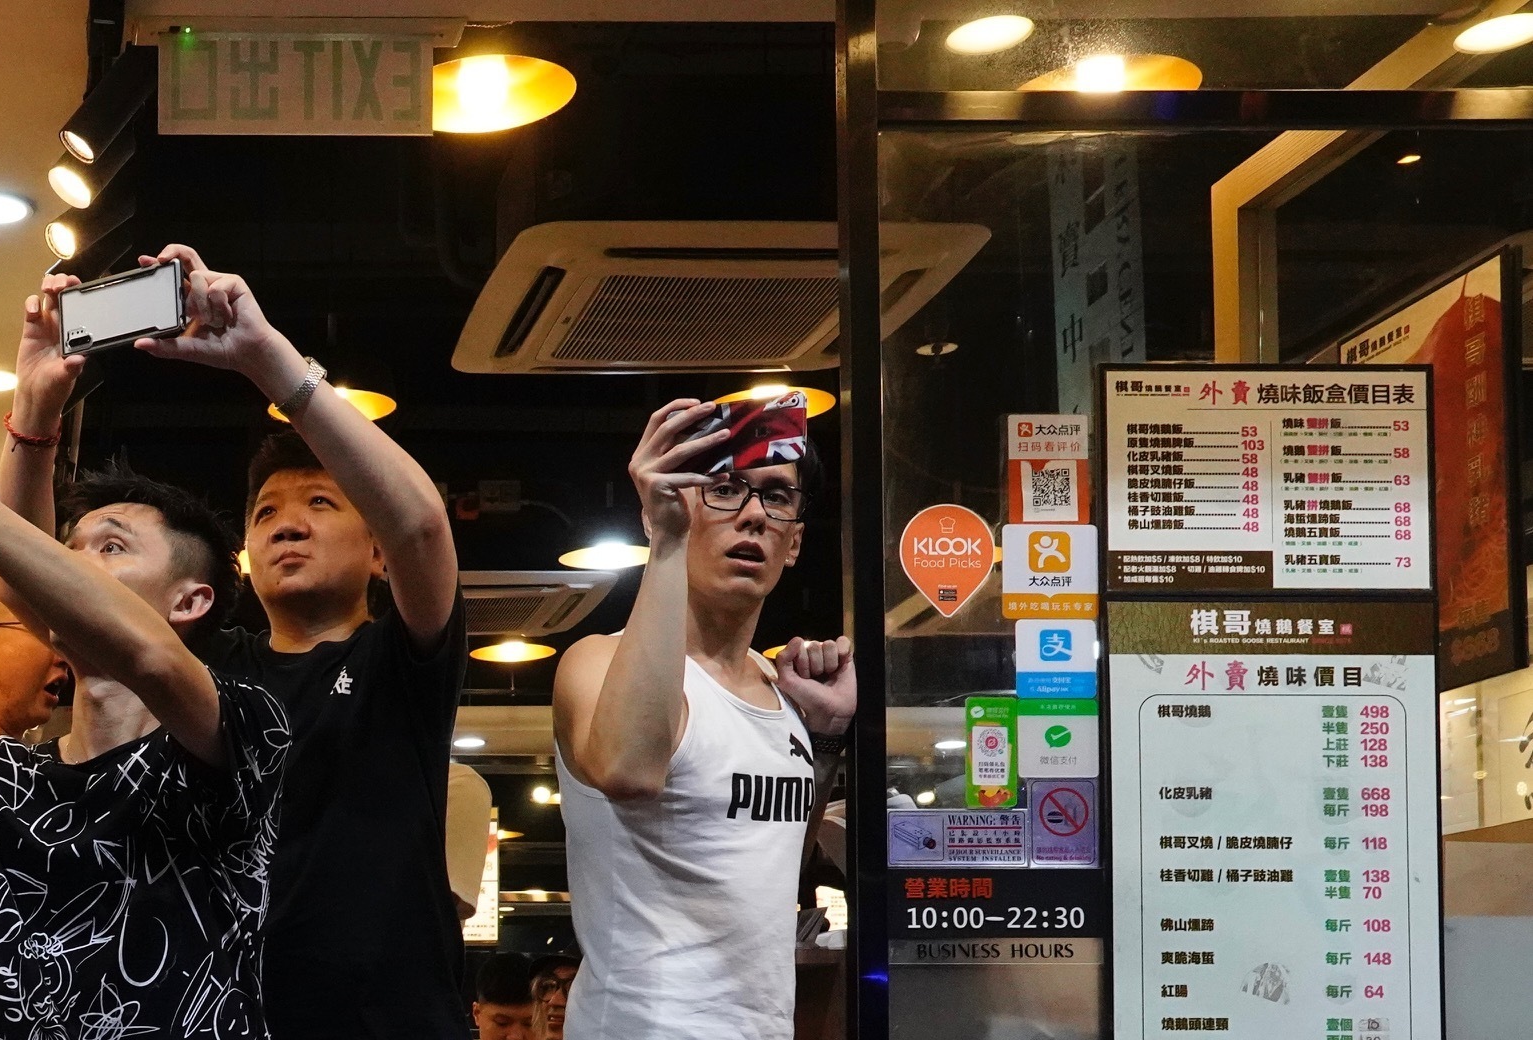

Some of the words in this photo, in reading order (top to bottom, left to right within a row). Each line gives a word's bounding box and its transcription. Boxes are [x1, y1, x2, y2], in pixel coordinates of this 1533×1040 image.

[1199, 380, 1251, 405] 外賣
[1257, 383, 1415, 405] 燒味飯盒價目表
[1035, 424, 1081, 436] 大众点评
[1241, 426, 1258, 437] 53
[1393, 421, 1409, 431] 53
[1017, 441, 1081, 453] 扫码看评价
[1241, 440, 1265, 451] 103
[1241, 453, 1258, 464] 58
[1393, 448, 1410, 459] 58
[1242, 467, 1259, 478] 48
[1242, 481, 1259, 491] 48
[1394, 475, 1410, 486] 63
[1242, 494, 1259, 505] 48
[1242, 508, 1259, 518] 48
[1394, 502, 1411, 513] 68
[1242, 522, 1259, 532] 48
[1394, 516, 1411, 526] 68
[1394, 530, 1411, 540] 68
[913, 537, 982, 555] KLOOK
[913, 558, 945, 569] Food
[949, 557, 982, 569] Picks
[1395, 557, 1411, 568] 73
[1028, 576, 1072, 587] 大众点评
[1190, 609, 1252, 636] 棋哥
[1254, 618, 1335, 636] 燒鵝餐室
[1184, 660, 1249, 691] 外賣
[1257, 665, 1363, 687] 燒味價目
[1157, 704, 1211, 718] 棋哥燒鵝
[1360, 705, 1389, 719] 498
[1322, 722, 1349, 735] 半隻
[1360, 722, 1389, 735] 250
[1322, 738, 1349, 751] 上莊
[1360, 738, 1388, 751] 128
[1039, 755, 1077, 765] 微信支付
[1322, 755, 1349, 768] 下莊
[1360, 755, 1389, 768] 138
[1158, 786, 1212, 800] 化皮乳豬
[1361, 787, 1390, 801] 668
[1323, 804, 1350, 817] 每斤
[1361, 804, 1389, 817] 198
[1159, 836, 1214, 850] 棋哥叉燒
[1225, 836, 1293, 850] 脆皮燒腩仔
[1323, 837, 1351, 850] 每斤
[1361, 837, 1388, 850] 118
[1160, 869, 1214, 883] 桂香切雞
[1226, 869, 1294, 883] 桶子豉油雞
[1362, 870, 1390, 883] 138
[904, 877, 994, 899] 營業時間
[1324, 886, 1351, 900] 半隻
[1362, 886, 1382, 900] 70
[1325, 919, 1352, 932] 每斤
[1363, 919, 1391, 932] 108
[917, 943, 1001, 959] BUSINESS
[1011, 943, 1075, 959] HOURS
[1161, 951, 1215, 965] 爽脆海蜇
[1325, 952, 1352, 965] 每斤
[1363, 952, 1392, 965] 148
[1161, 985, 1188, 998] 紅腸
[1325, 985, 1353, 998] 每斤
[1363, 985, 1384, 998] 64
[1161, 1018, 1229, 1031] 燒鵝頭連頸
